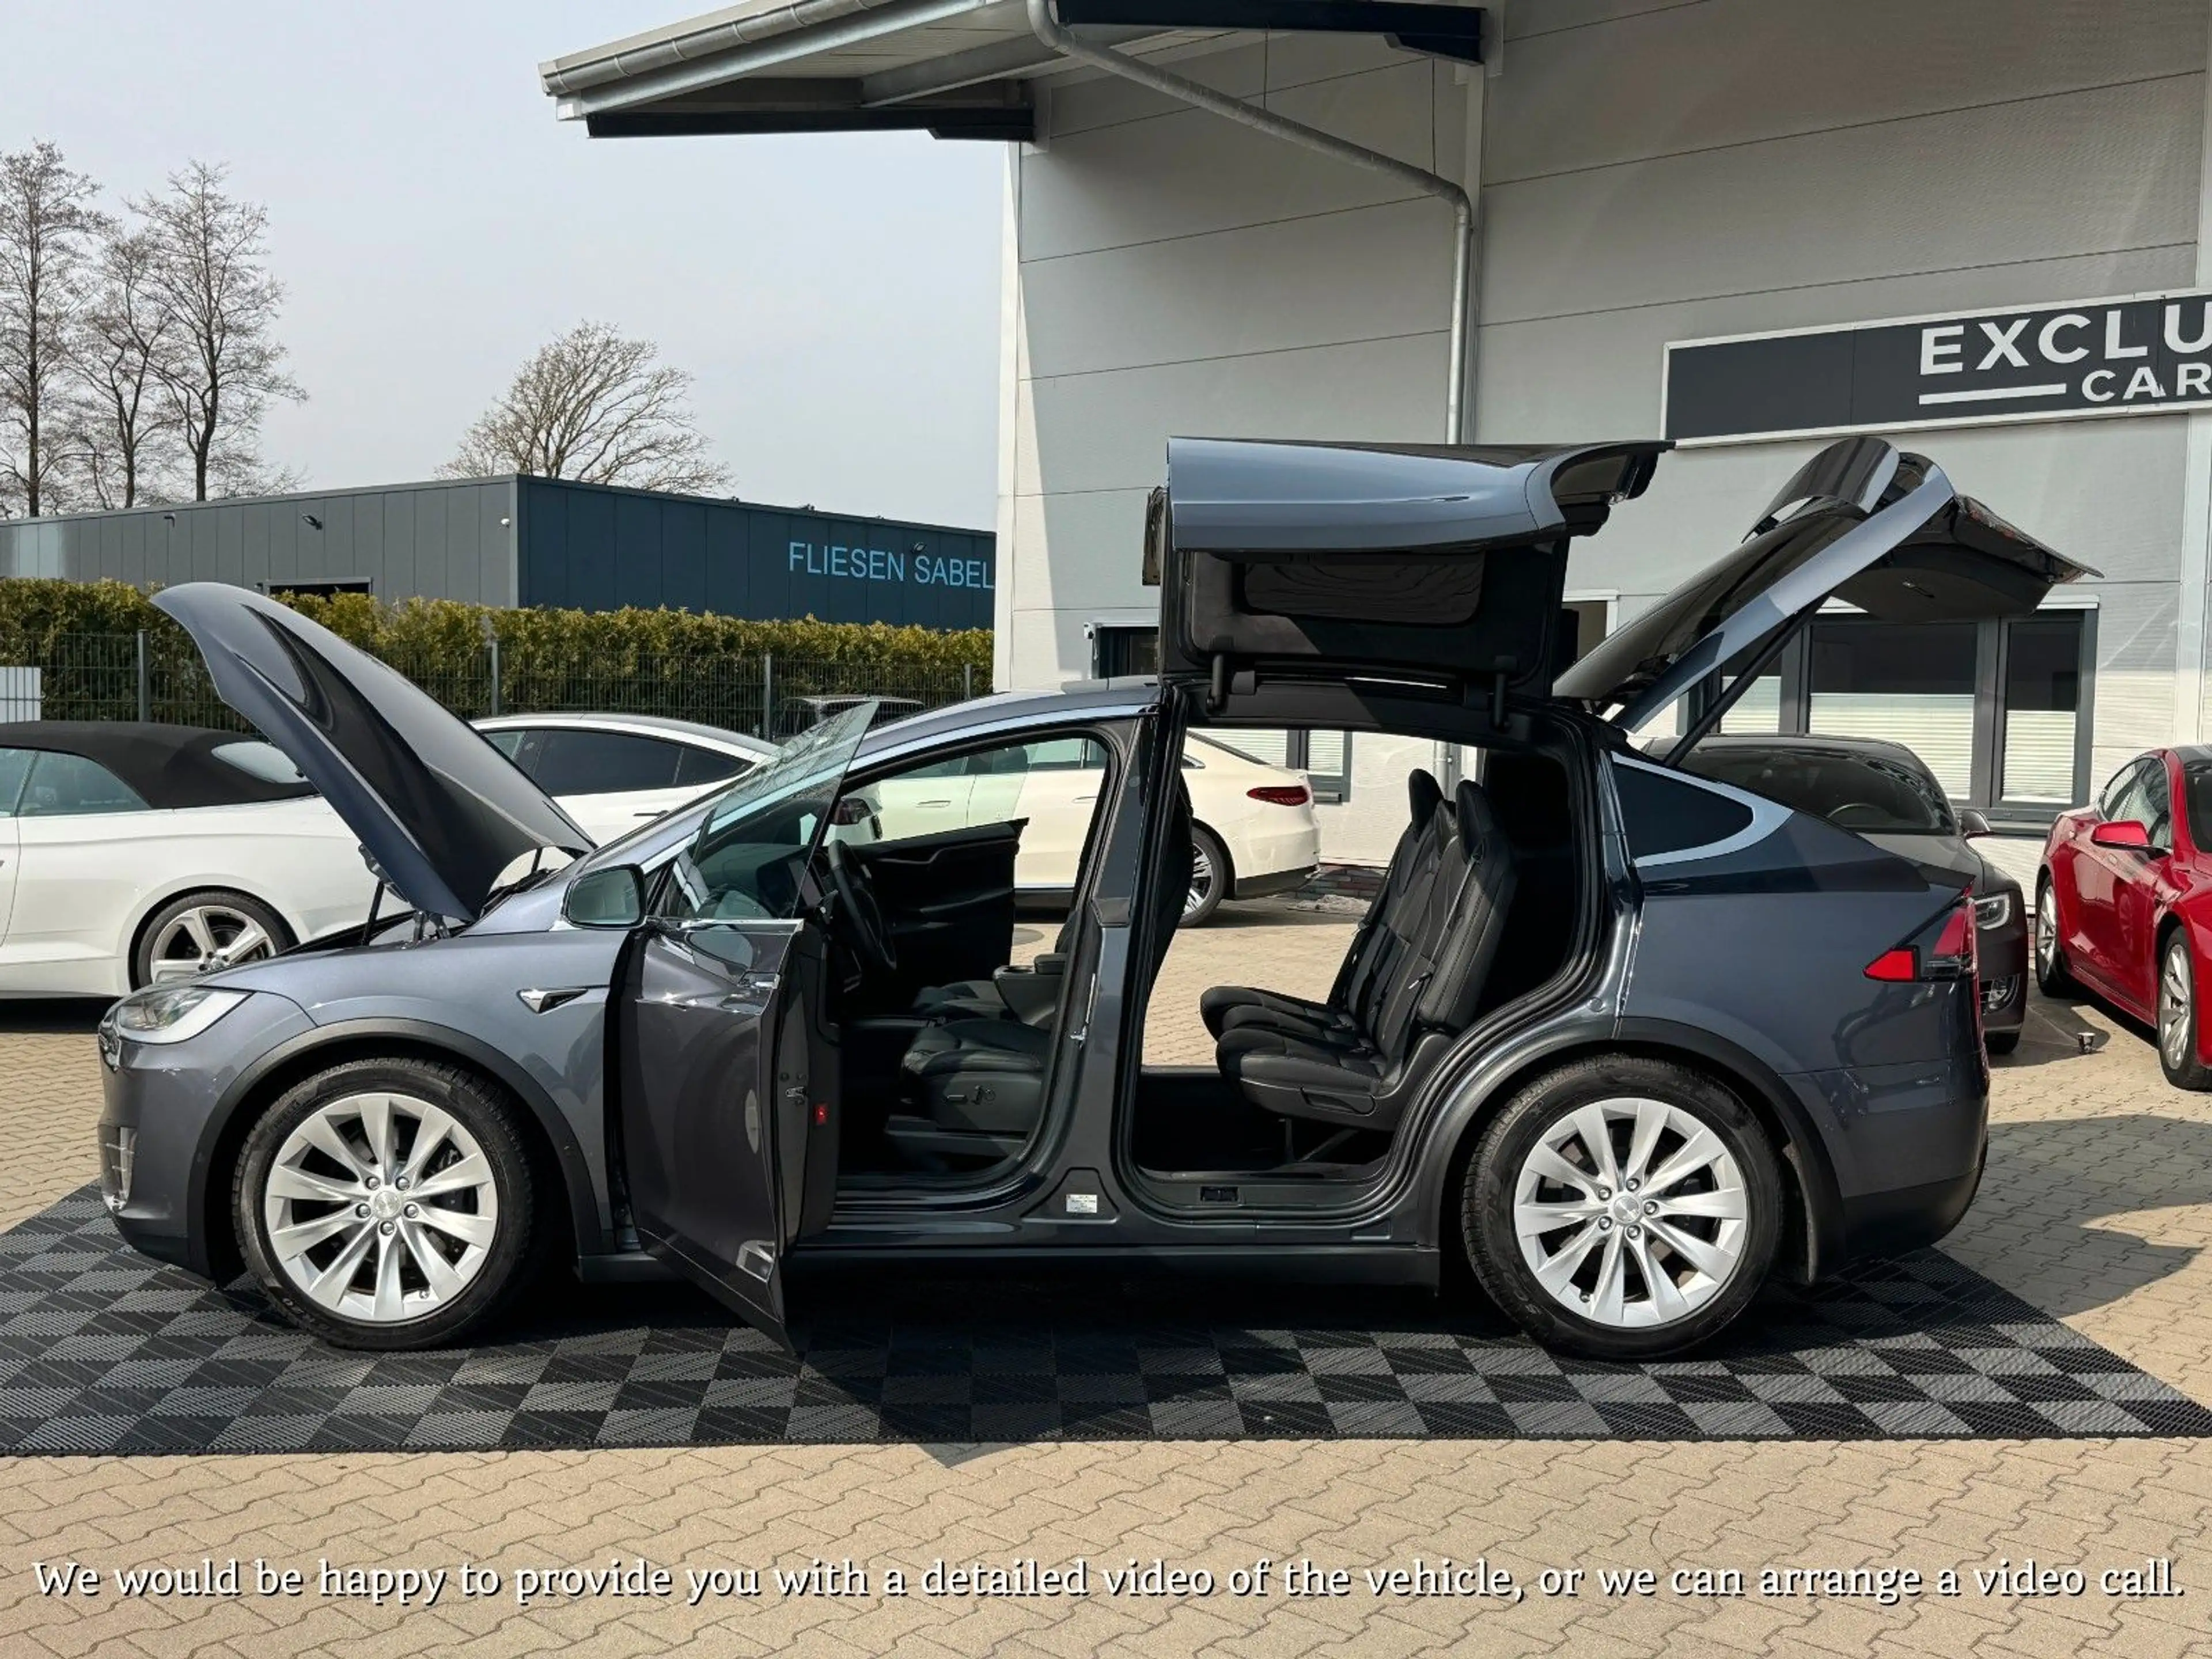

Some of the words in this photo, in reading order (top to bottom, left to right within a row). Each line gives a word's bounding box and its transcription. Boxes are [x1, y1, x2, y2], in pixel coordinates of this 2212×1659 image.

[1919, 301, 2212, 376] EXCLU
[2081, 362, 2212, 403] CAR
[789, 541, 904, 582] FLIESEN
[914, 555, 995, 589] SABEL
